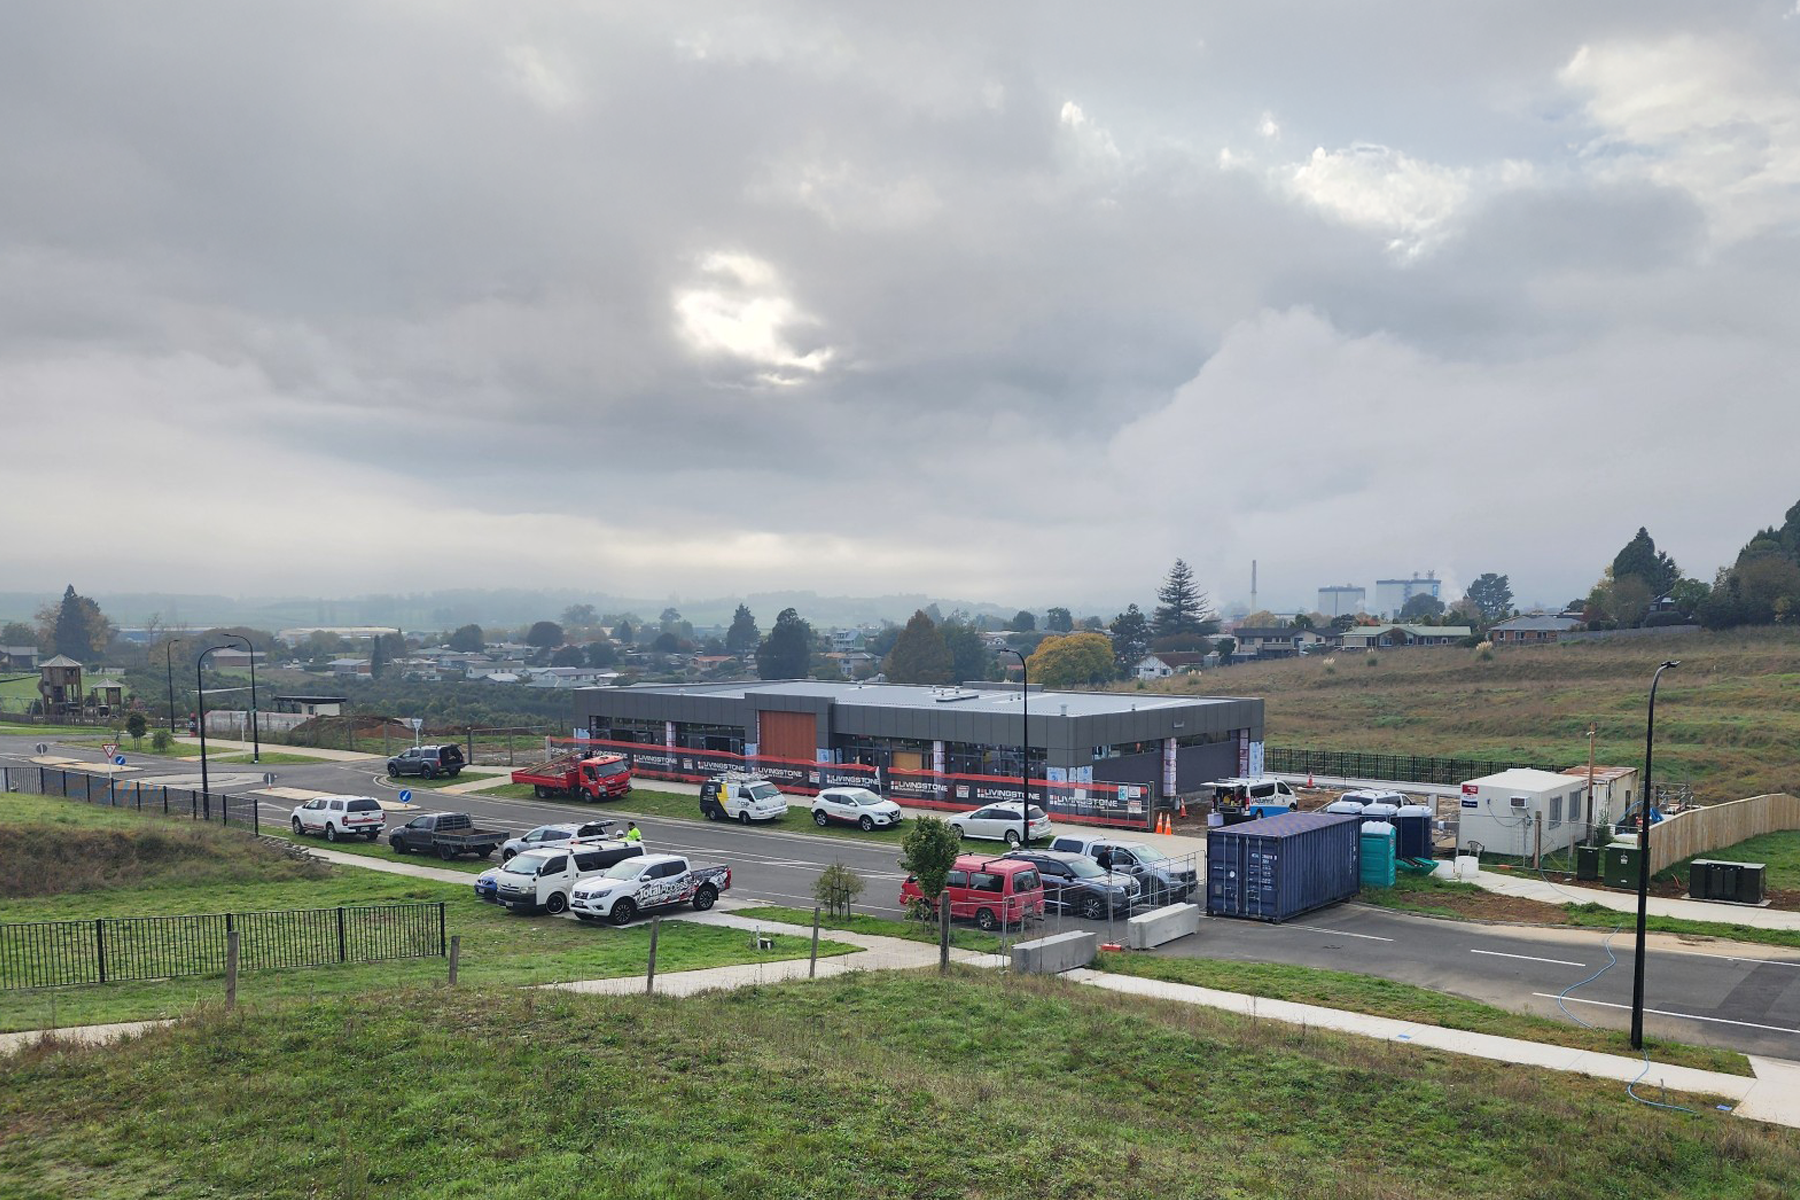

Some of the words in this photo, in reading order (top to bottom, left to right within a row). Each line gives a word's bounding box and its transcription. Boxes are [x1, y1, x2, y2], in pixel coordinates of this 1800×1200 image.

[638, 754, 678, 765] LIVINGSTONE
[703, 761, 746, 771] LIVINGSTONE
[758, 767, 803, 778] LIVINGSTONE
[832, 774, 880, 785] LIVINGSTONE
[898, 781, 949, 792] LIVINGSTONE
[984, 788, 1041, 801] LIVINGSTNE
[639, 883, 661, 898] Total
